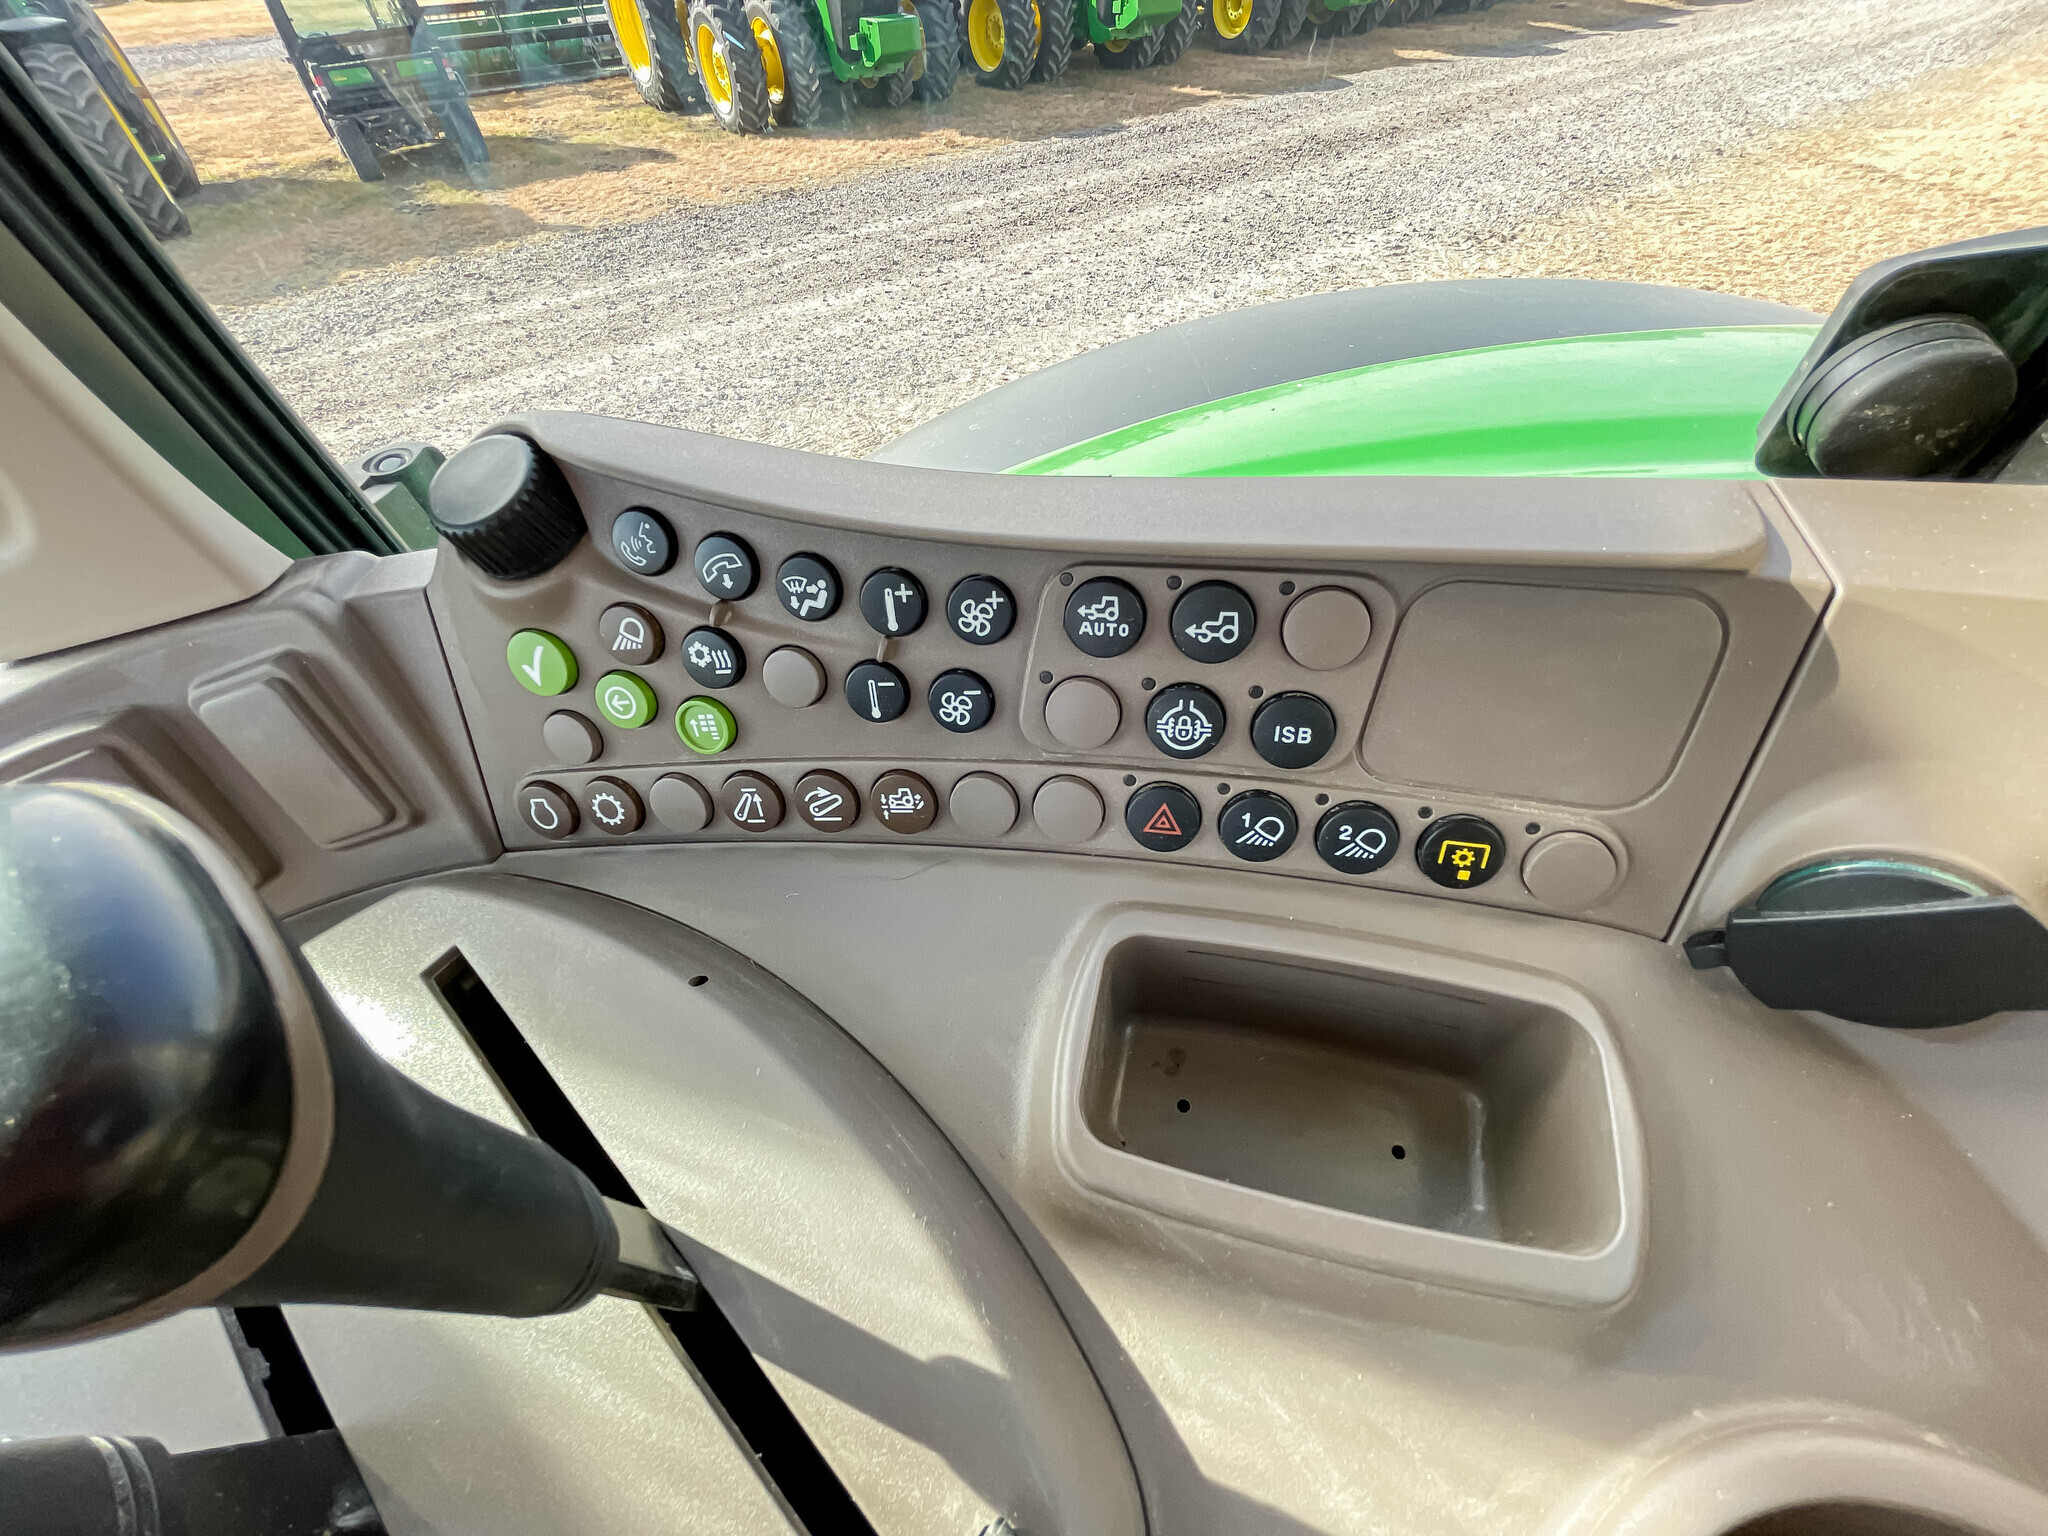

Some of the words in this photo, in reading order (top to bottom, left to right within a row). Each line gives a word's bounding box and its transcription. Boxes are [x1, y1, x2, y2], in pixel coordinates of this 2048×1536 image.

[1078, 621, 1130, 637] AUTO
[1273, 725, 1313, 745] ISB
[1241, 812, 1251, 828] 1
[1338, 824, 1353, 841] 2
